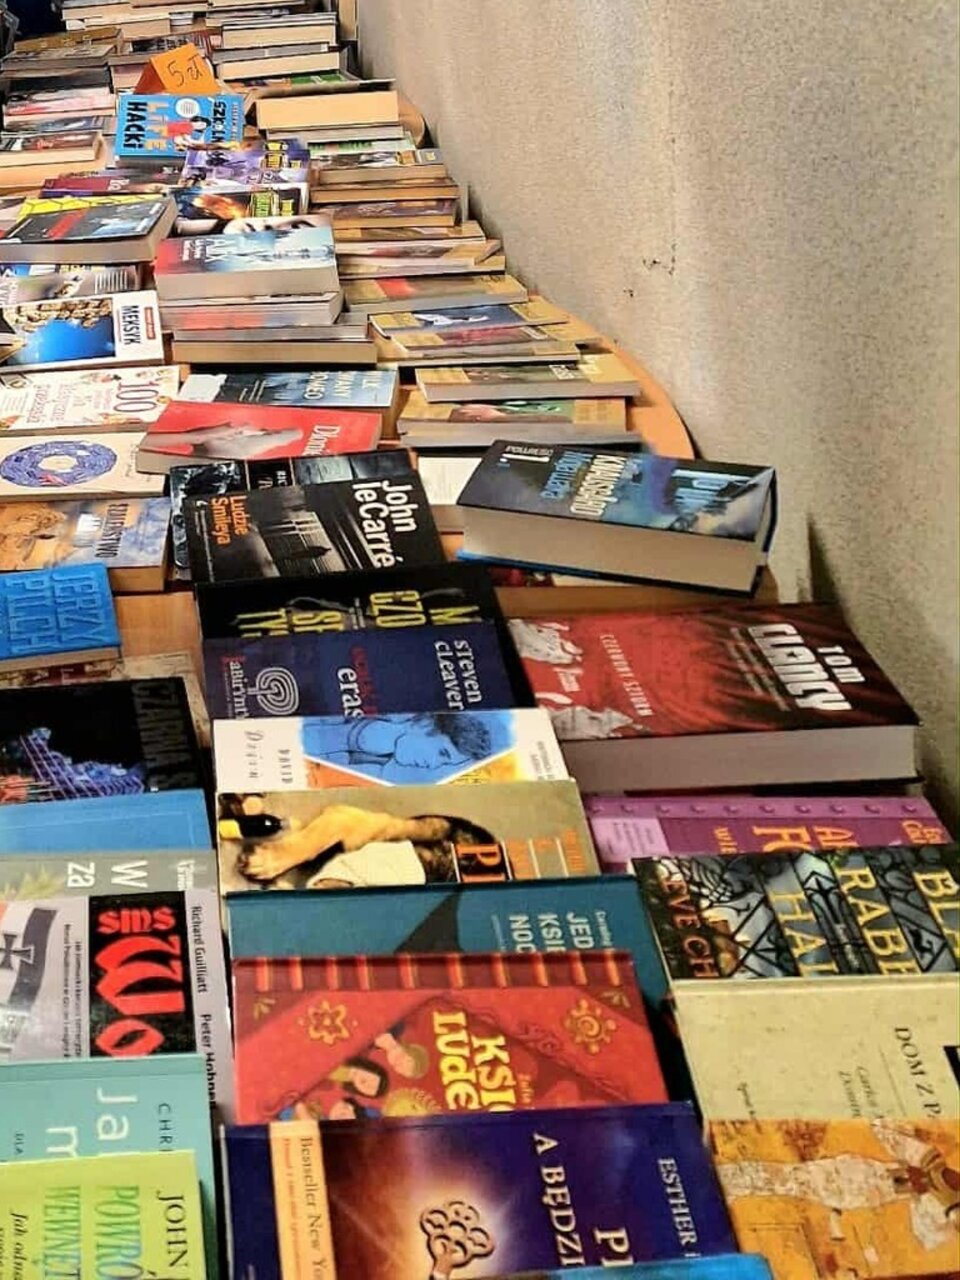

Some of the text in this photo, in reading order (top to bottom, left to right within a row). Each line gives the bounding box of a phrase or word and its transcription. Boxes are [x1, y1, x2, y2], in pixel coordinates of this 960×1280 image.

[167, 60, 185, 88] 5
[120, 305, 142, 345] MEKSYK
[114, 381, 160, 413] 100
[211, 497, 232, 545] Smileya
[230, 495, 250, 535] Ludzie
[382, 480, 419, 532] John
[5, 576, 57, 655] PILCH
[52, 571, 106, 642] JERZY
[600, 634, 654, 716] CZERWONY SZTORM
[747, 623, 852, 711] CLANCY
[191, 906, 204, 945] Richard
[661, 878, 701, 929] EVE
[566, 912, 594, 949] JED
[194, 947, 208, 993] Guilliatt
[200, 1014, 213, 1048] Peter
[894, 1027, 927, 1076] DOM
[915, 1083, 934, 1097] Z
[96, 1089, 139, 1140] Ja
[300, 1137, 320, 1208] Bestseller
[11, 1213, 29, 1236] Jak
[533, 1133, 586, 1266] A BĘDZI
[658, 1158, 698, 1245] ESTHER
[156, 1190, 188, 1268] JOHN
[307, 1213, 323, 1251] New
